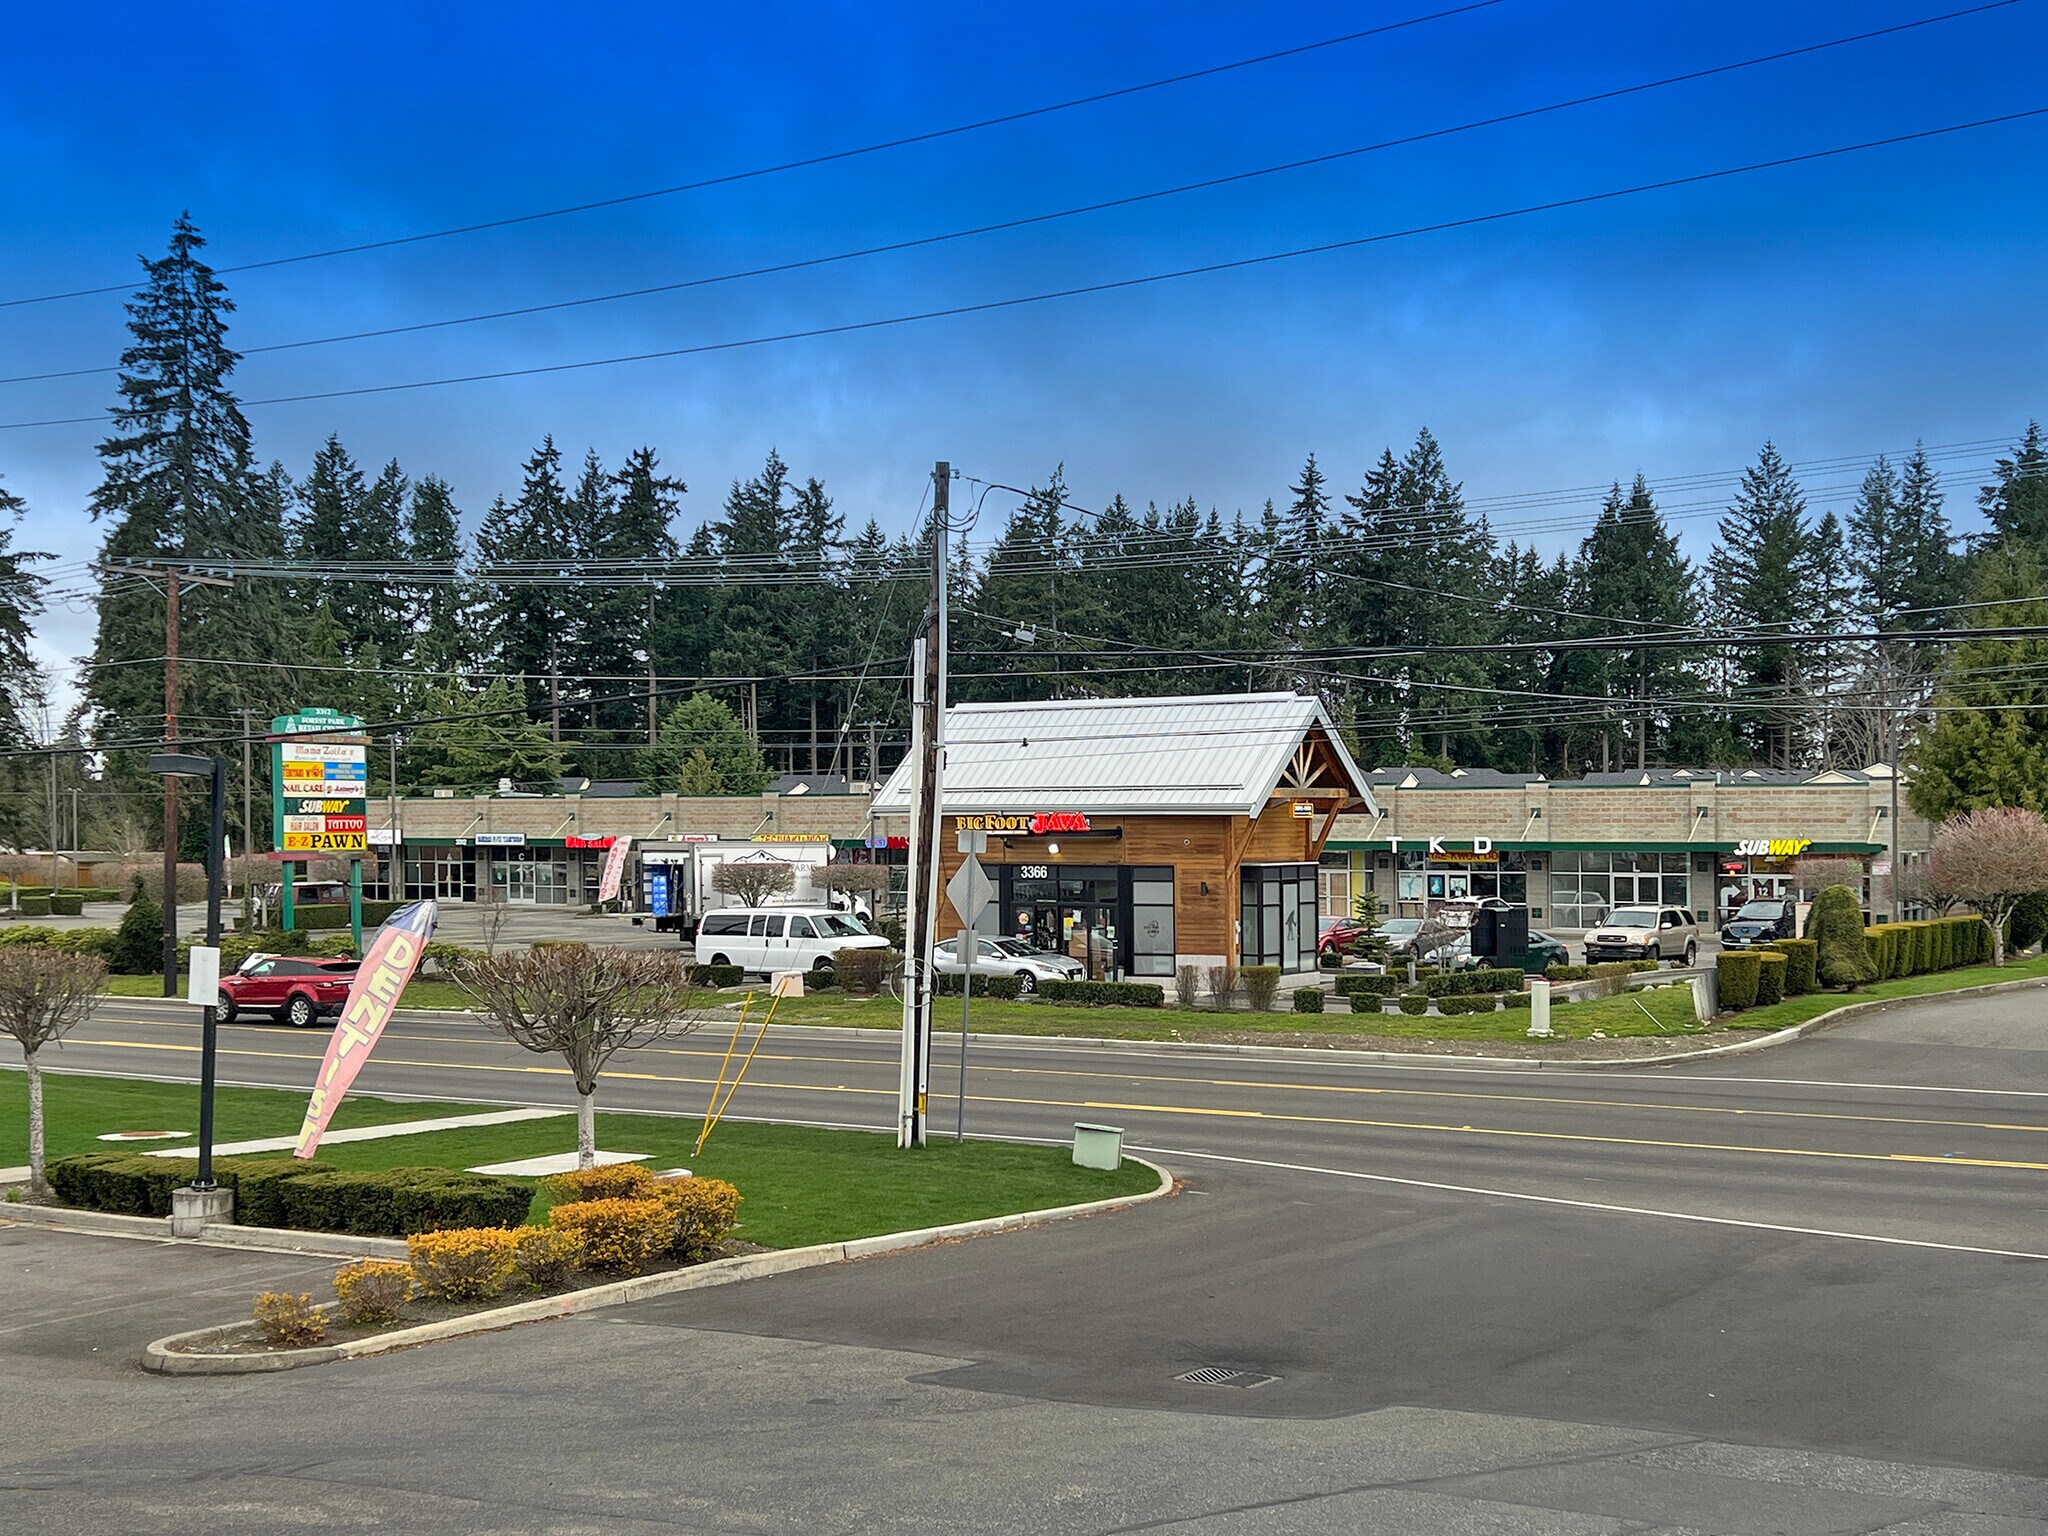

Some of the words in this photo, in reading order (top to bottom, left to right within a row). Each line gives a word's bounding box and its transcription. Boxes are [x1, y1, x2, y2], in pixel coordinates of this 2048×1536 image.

[282, 784, 303, 792] NAIL
[303, 784, 324, 792] CARE
[298, 800, 350, 813] SUBWAY
[327, 819, 363, 829] TATTOO
[1031, 811, 1090, 834] JAVA
[287, 836, 309, 847] E-Z
[310, 834, 364, 848] PAWN
[1733, 838, 1812, 856] SUBWAY
[518, 852, 526, 861] C
[1484, 851, 1499, 860] DO
[1020, 865, 1048, 879] 3366
[296, 934, 414, 1152] DENTIST
